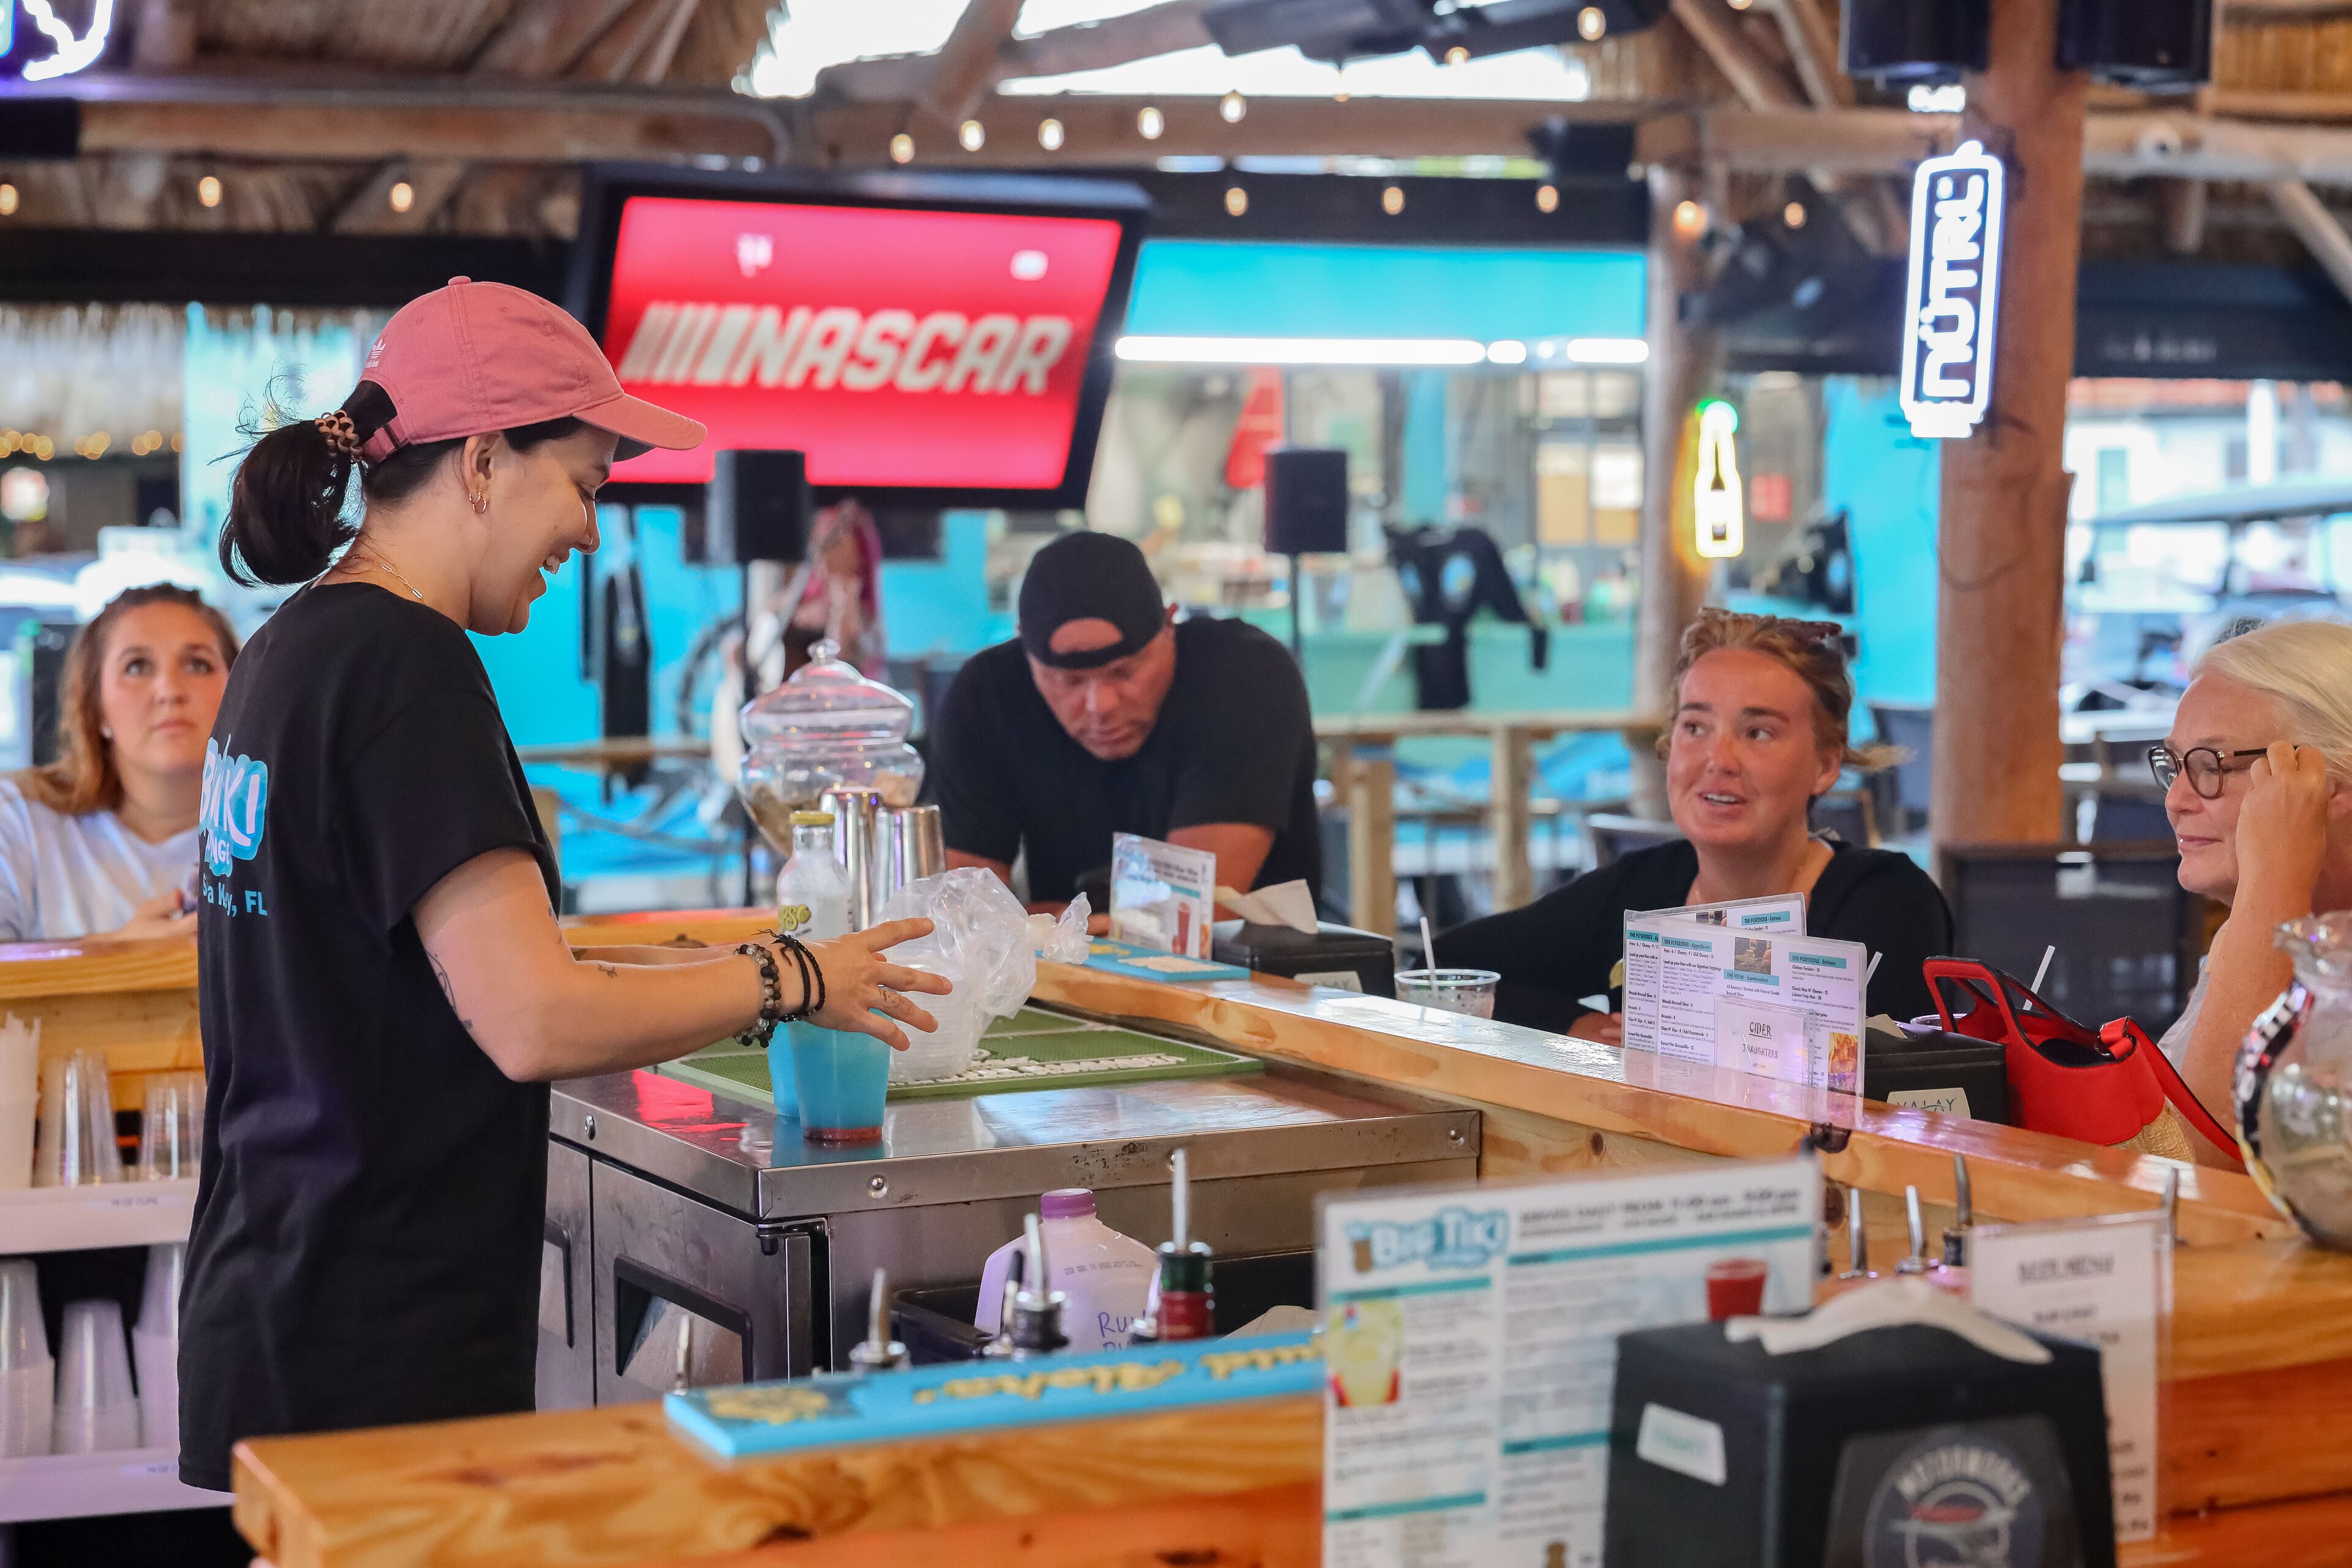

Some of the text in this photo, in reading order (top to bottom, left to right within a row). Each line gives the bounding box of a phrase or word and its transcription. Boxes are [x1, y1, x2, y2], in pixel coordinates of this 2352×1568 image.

[732, 303, 1073, 395] NASCAR
[218, 882, 237, 918] Ky,
[245, 890, 268, 916] FL
[1749, 1022, 1772, 1037] CIDER
[1743, 1044, 1778, 1058] 3 DAUGHTERS
[1097, 1311, 1147, 1338] RU
